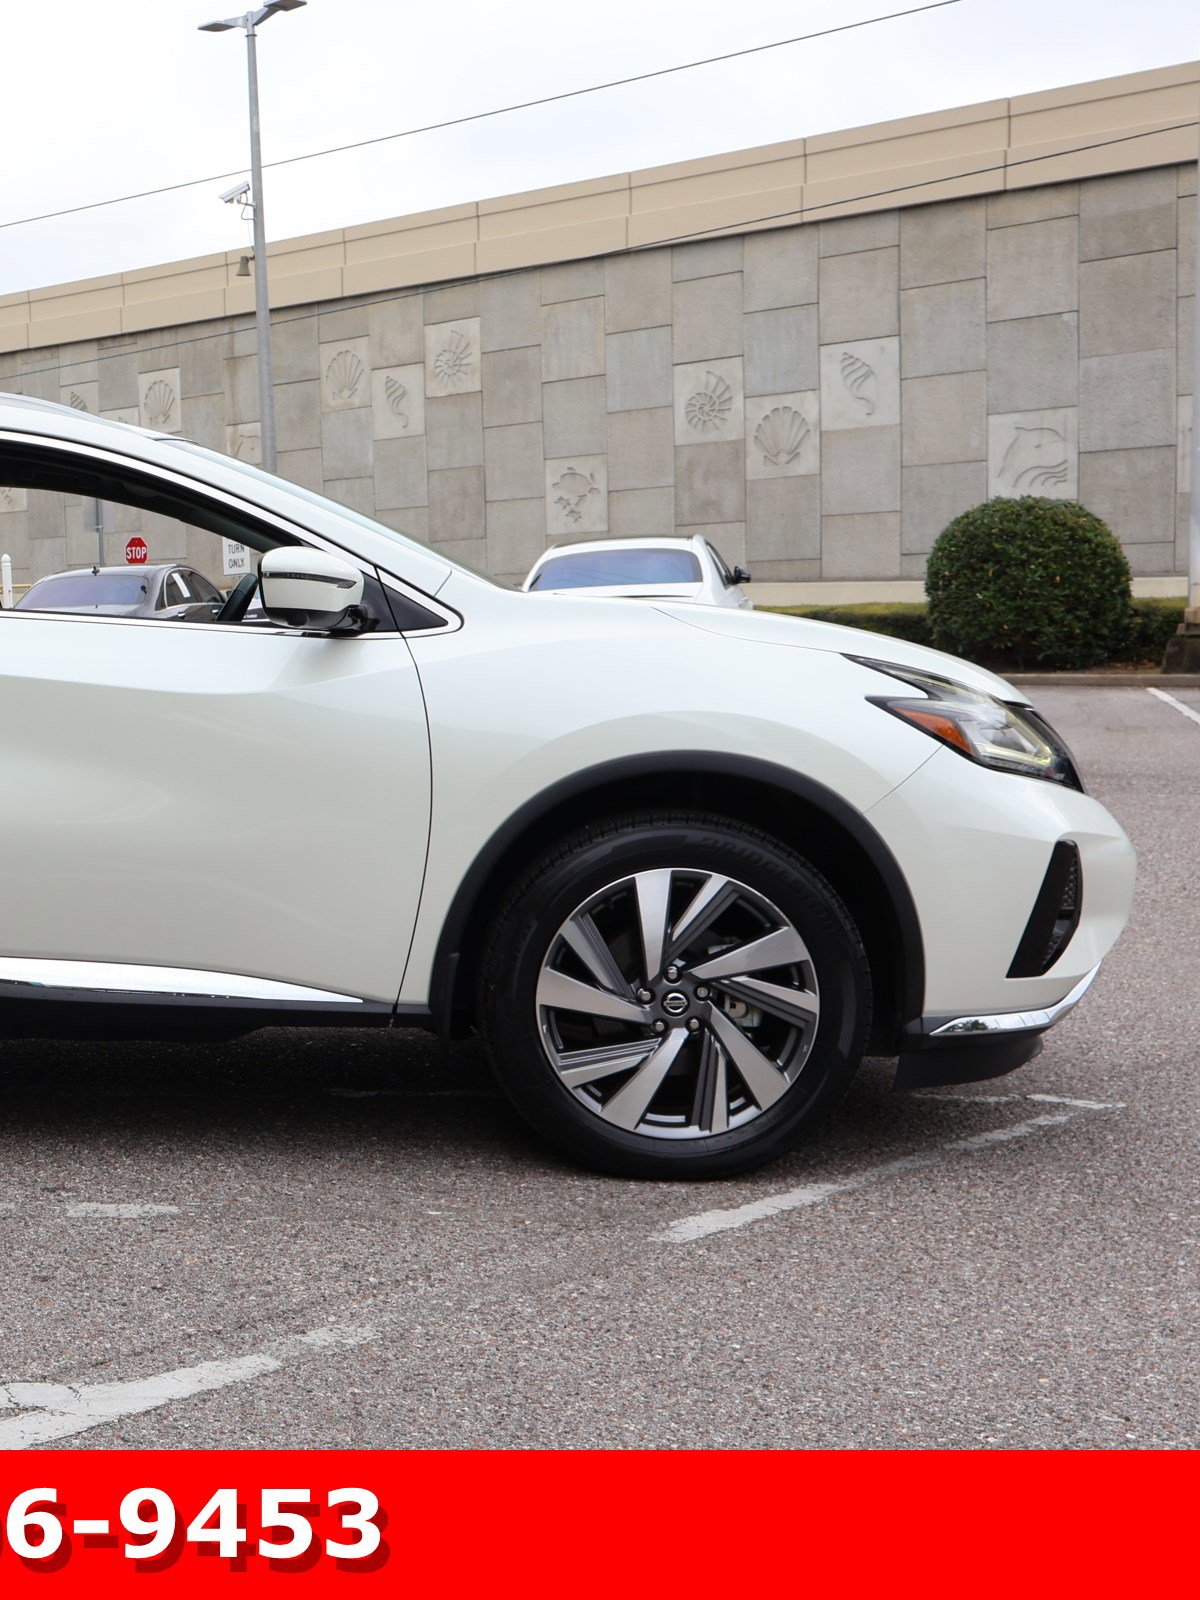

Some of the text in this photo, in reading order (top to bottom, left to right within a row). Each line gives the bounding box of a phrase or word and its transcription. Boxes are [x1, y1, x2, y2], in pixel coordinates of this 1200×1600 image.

[126, 547, 147, 559] STOP
[228, 544, 245, 555] TURN
[228, 558, 245, 569] ONLY
